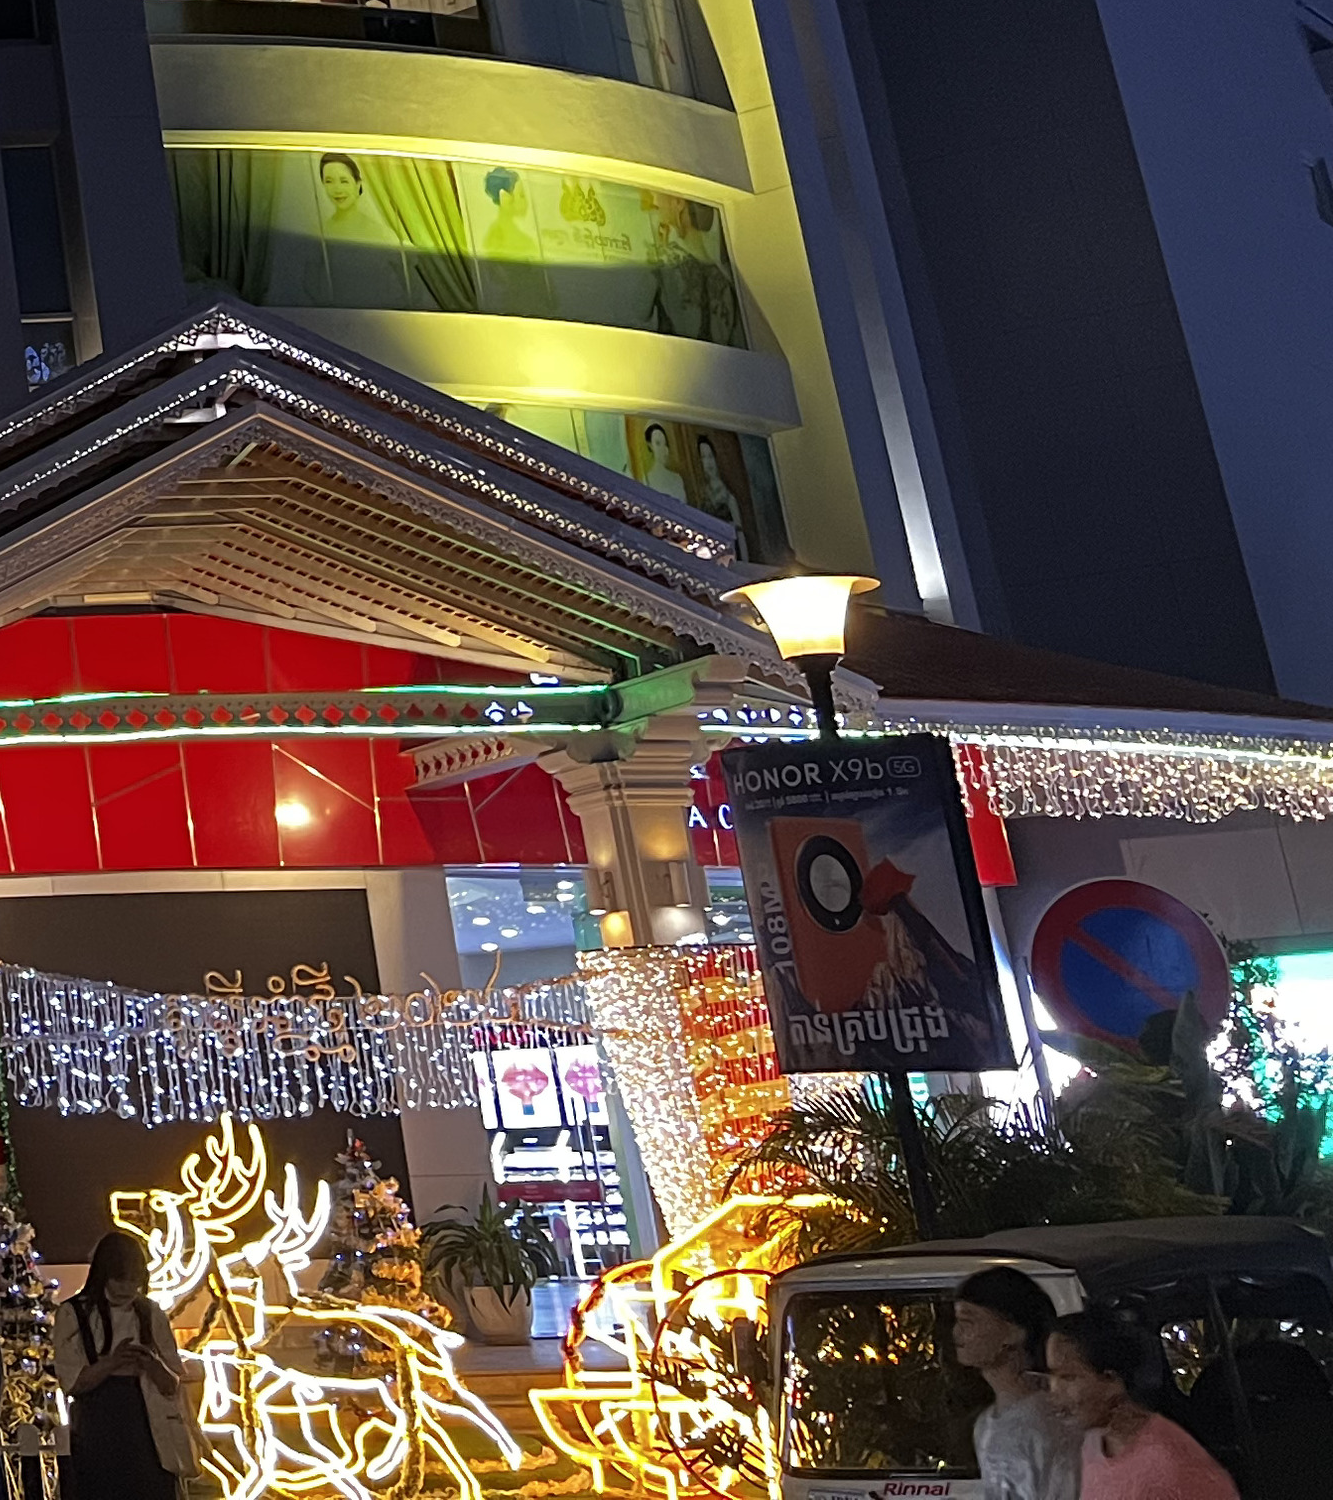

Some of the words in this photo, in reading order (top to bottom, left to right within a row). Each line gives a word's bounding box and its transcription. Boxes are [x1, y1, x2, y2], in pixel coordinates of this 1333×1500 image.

[733, 762, 823, 796] HONOR
[827, 757, 884, 783] X9b
[883, 1481, 951, 1497] Rinnai
